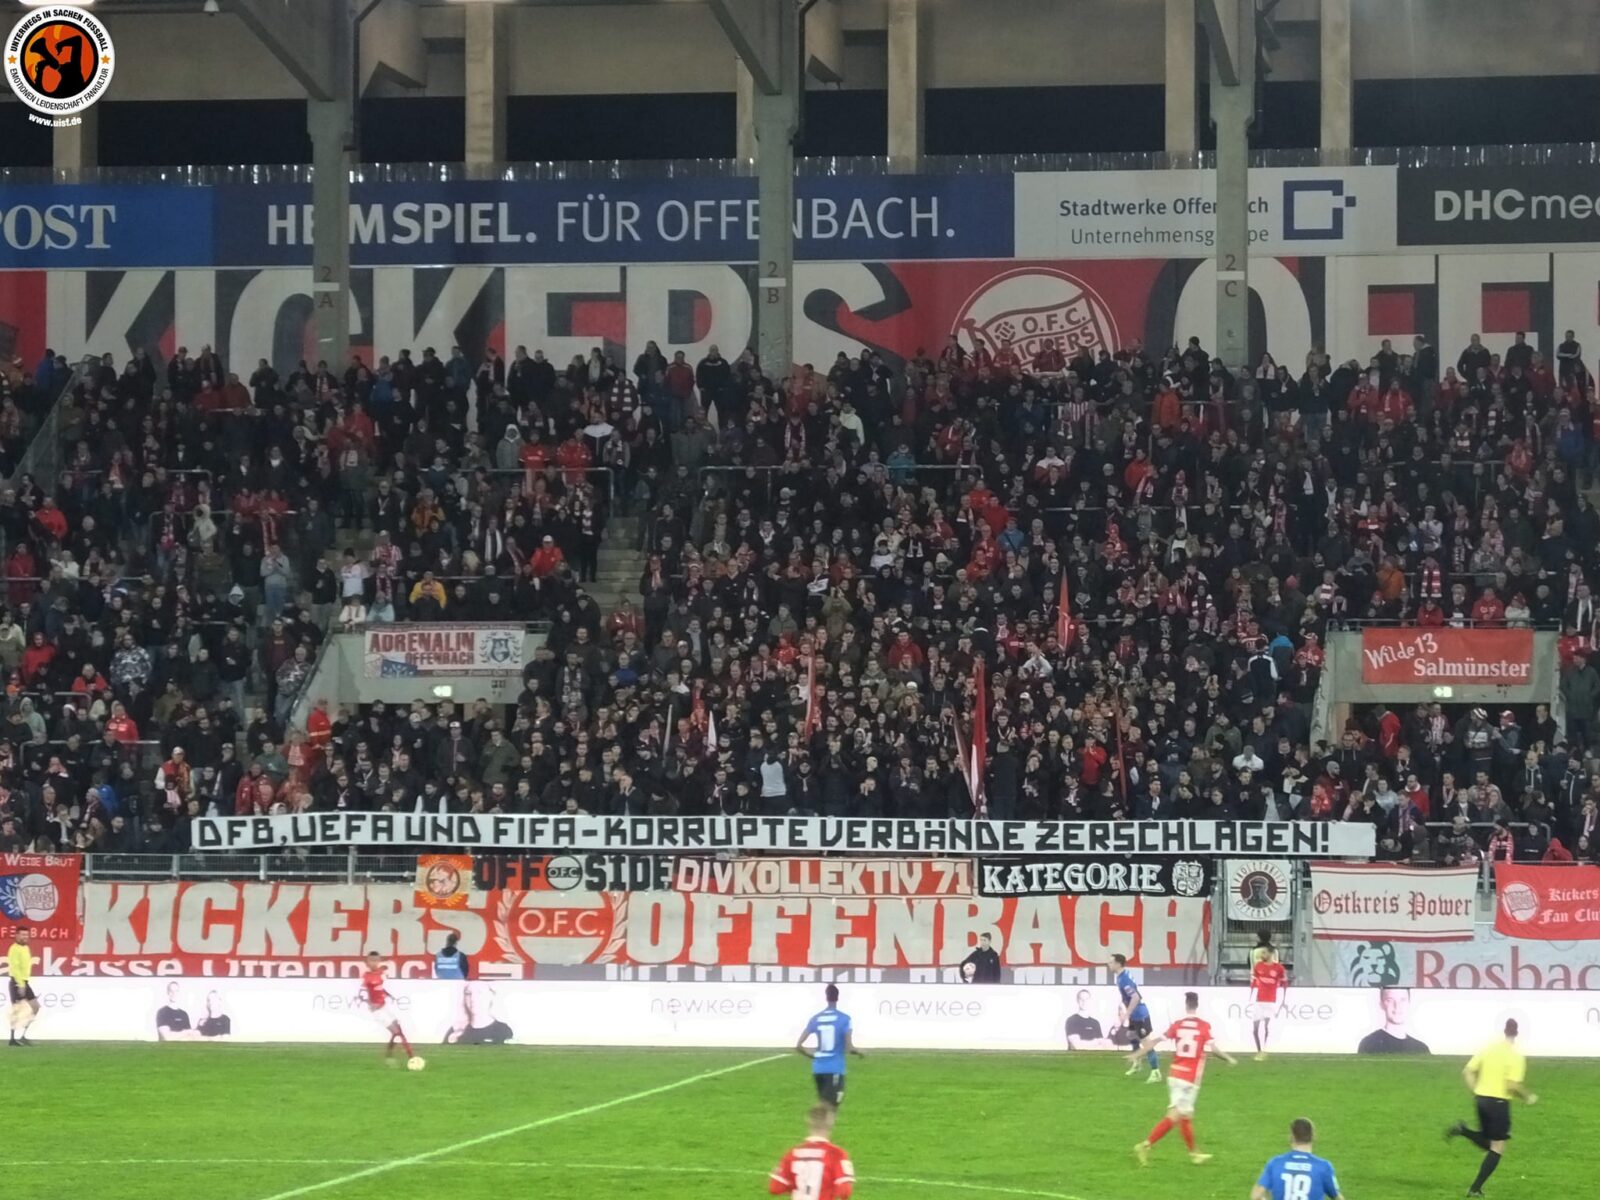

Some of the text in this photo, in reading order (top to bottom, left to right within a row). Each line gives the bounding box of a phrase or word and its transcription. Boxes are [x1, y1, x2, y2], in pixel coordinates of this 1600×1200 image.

[1059, 197, 1269, 217] Stadtwerke Offech
[0, 203, 116, 250] OST
[557, 193, 641, 242] FÜR
[1071, 225, 1269, 246] Unternehmensgpe
[767, 260, 779, 278] 2
[1224, 253, 1237, 271] 2
[320, 265, 332, 282] 2
[767, 286, 780, 304] B
[1224, 280, 1238, 297] C
[318, 294, 334, 308] A
[1022, 307, 1088, 334] O.F.C.
[1019, 326, 1096, 362] ICKERS
[369, 632, 475, 652] ADRENALIN
[1364, 632, 1439, 670] Wilde 13
[404, 651, 475, 665] OFFENBACH
[1413, 657, 1530, 677] Salmünster
[404, 815, 482, 842] UND
[818, 819, 1025, 852] VERBÄNDE
[1034, 821, 1330, 853] ZERSCHLAGEN!
[585, 854, 675, 892] SIDE
[734, 861, 923, 895] KOLLEKTIV
[931, 862, 972, 894] 71
[983, 862, 1165, 894] KATEGORIE
[1314, 889, 1473, 920] Ostkreis Power
[78, 882, 1208, 966] KICKERS O.F.C. OFFENBACH
[1538, 908, 1600, 924] Fan Clu
[650, 998, 752, 1015] newkee
[878, 999, 982, 1016] newkee
